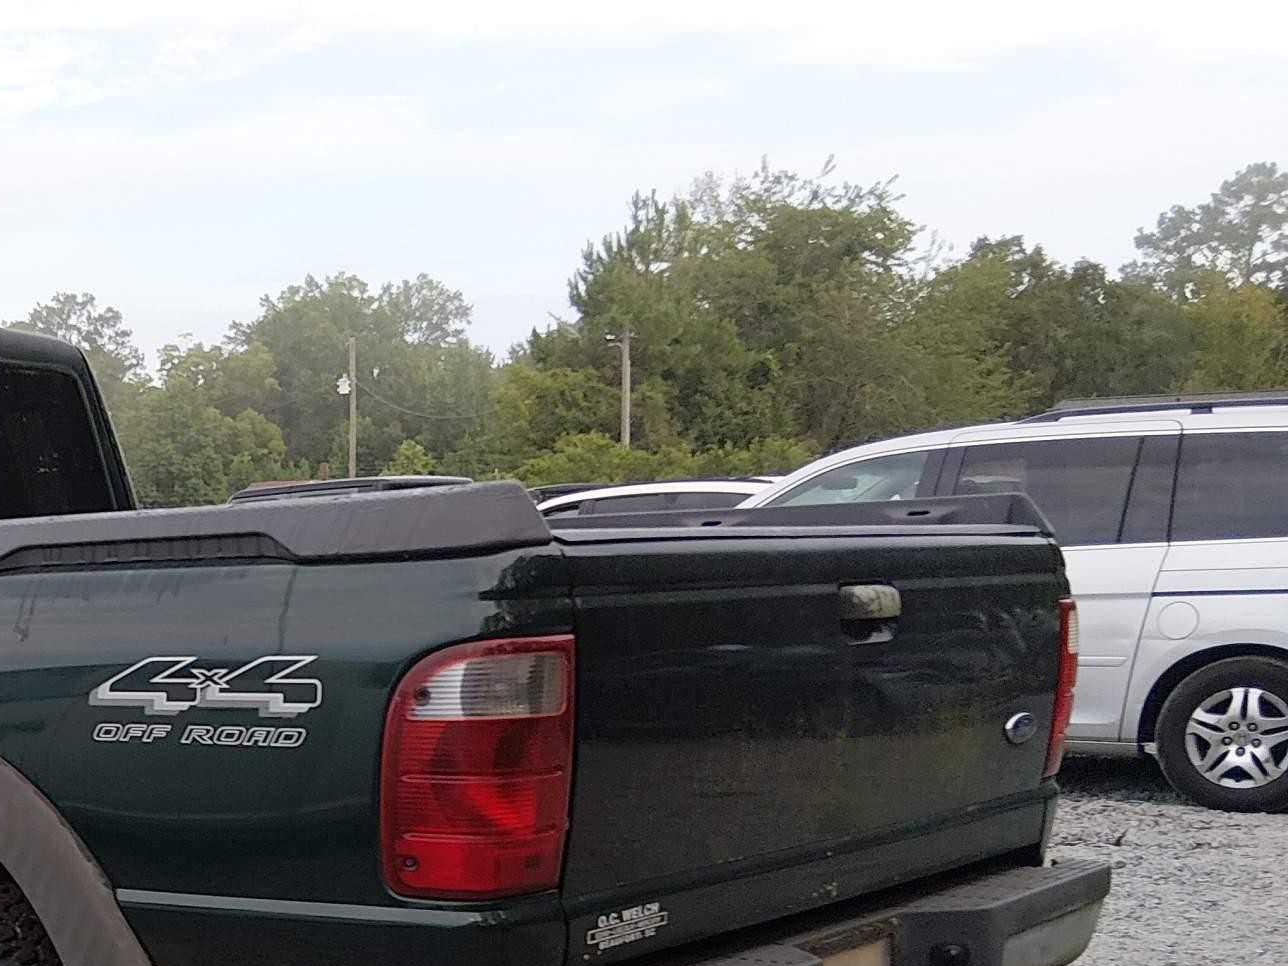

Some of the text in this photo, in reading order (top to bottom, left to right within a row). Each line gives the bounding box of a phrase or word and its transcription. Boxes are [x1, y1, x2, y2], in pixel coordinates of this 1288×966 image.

[92, 722, 308, 748] OFF ROAD
[621, 902, 660, 921] WELCH
